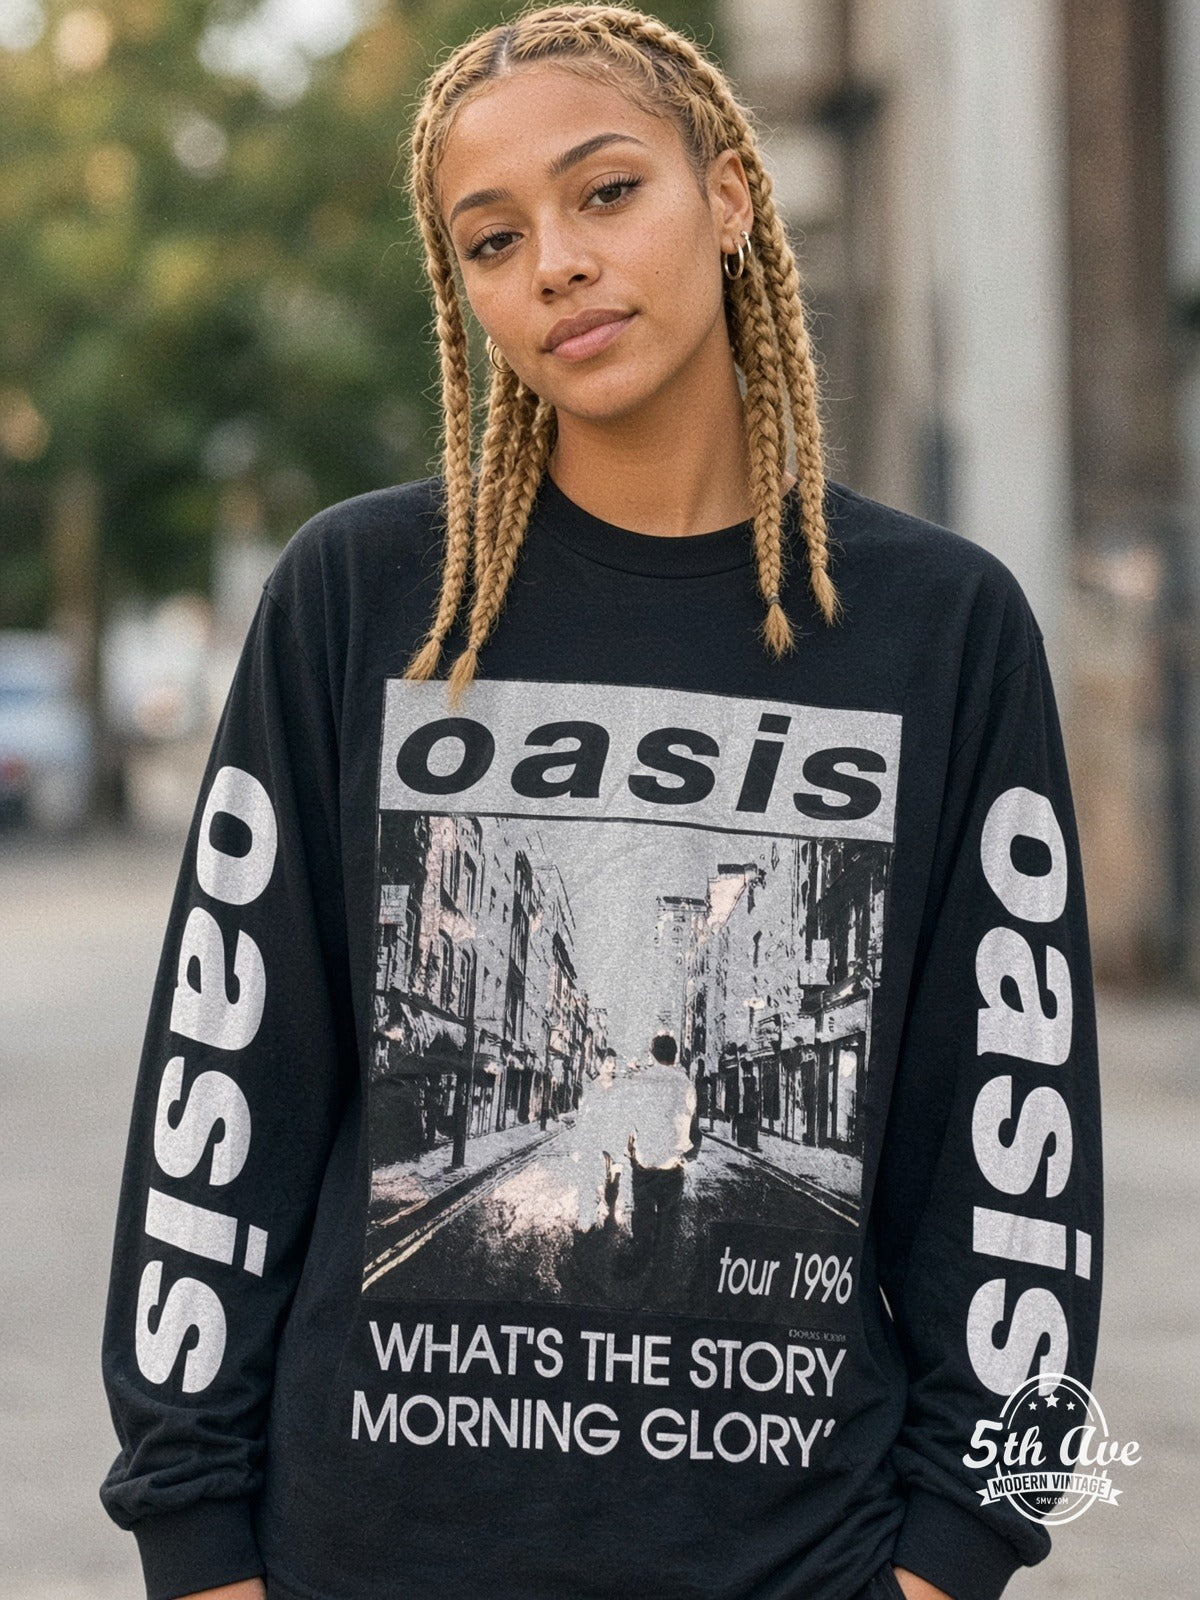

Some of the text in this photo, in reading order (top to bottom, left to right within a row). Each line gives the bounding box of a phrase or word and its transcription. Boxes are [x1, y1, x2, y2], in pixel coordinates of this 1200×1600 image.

[396, 713, 887, 821] oasis
[135, 765, 278, 1393] oasis
[966, 786, 1092, 1397] oasis
[717, 1247, 853, 1305] tour 1996
[369, 1321, 847, 1397] WHAT'S THE STORY
[351, 1390, 620, 1455] MORNING
